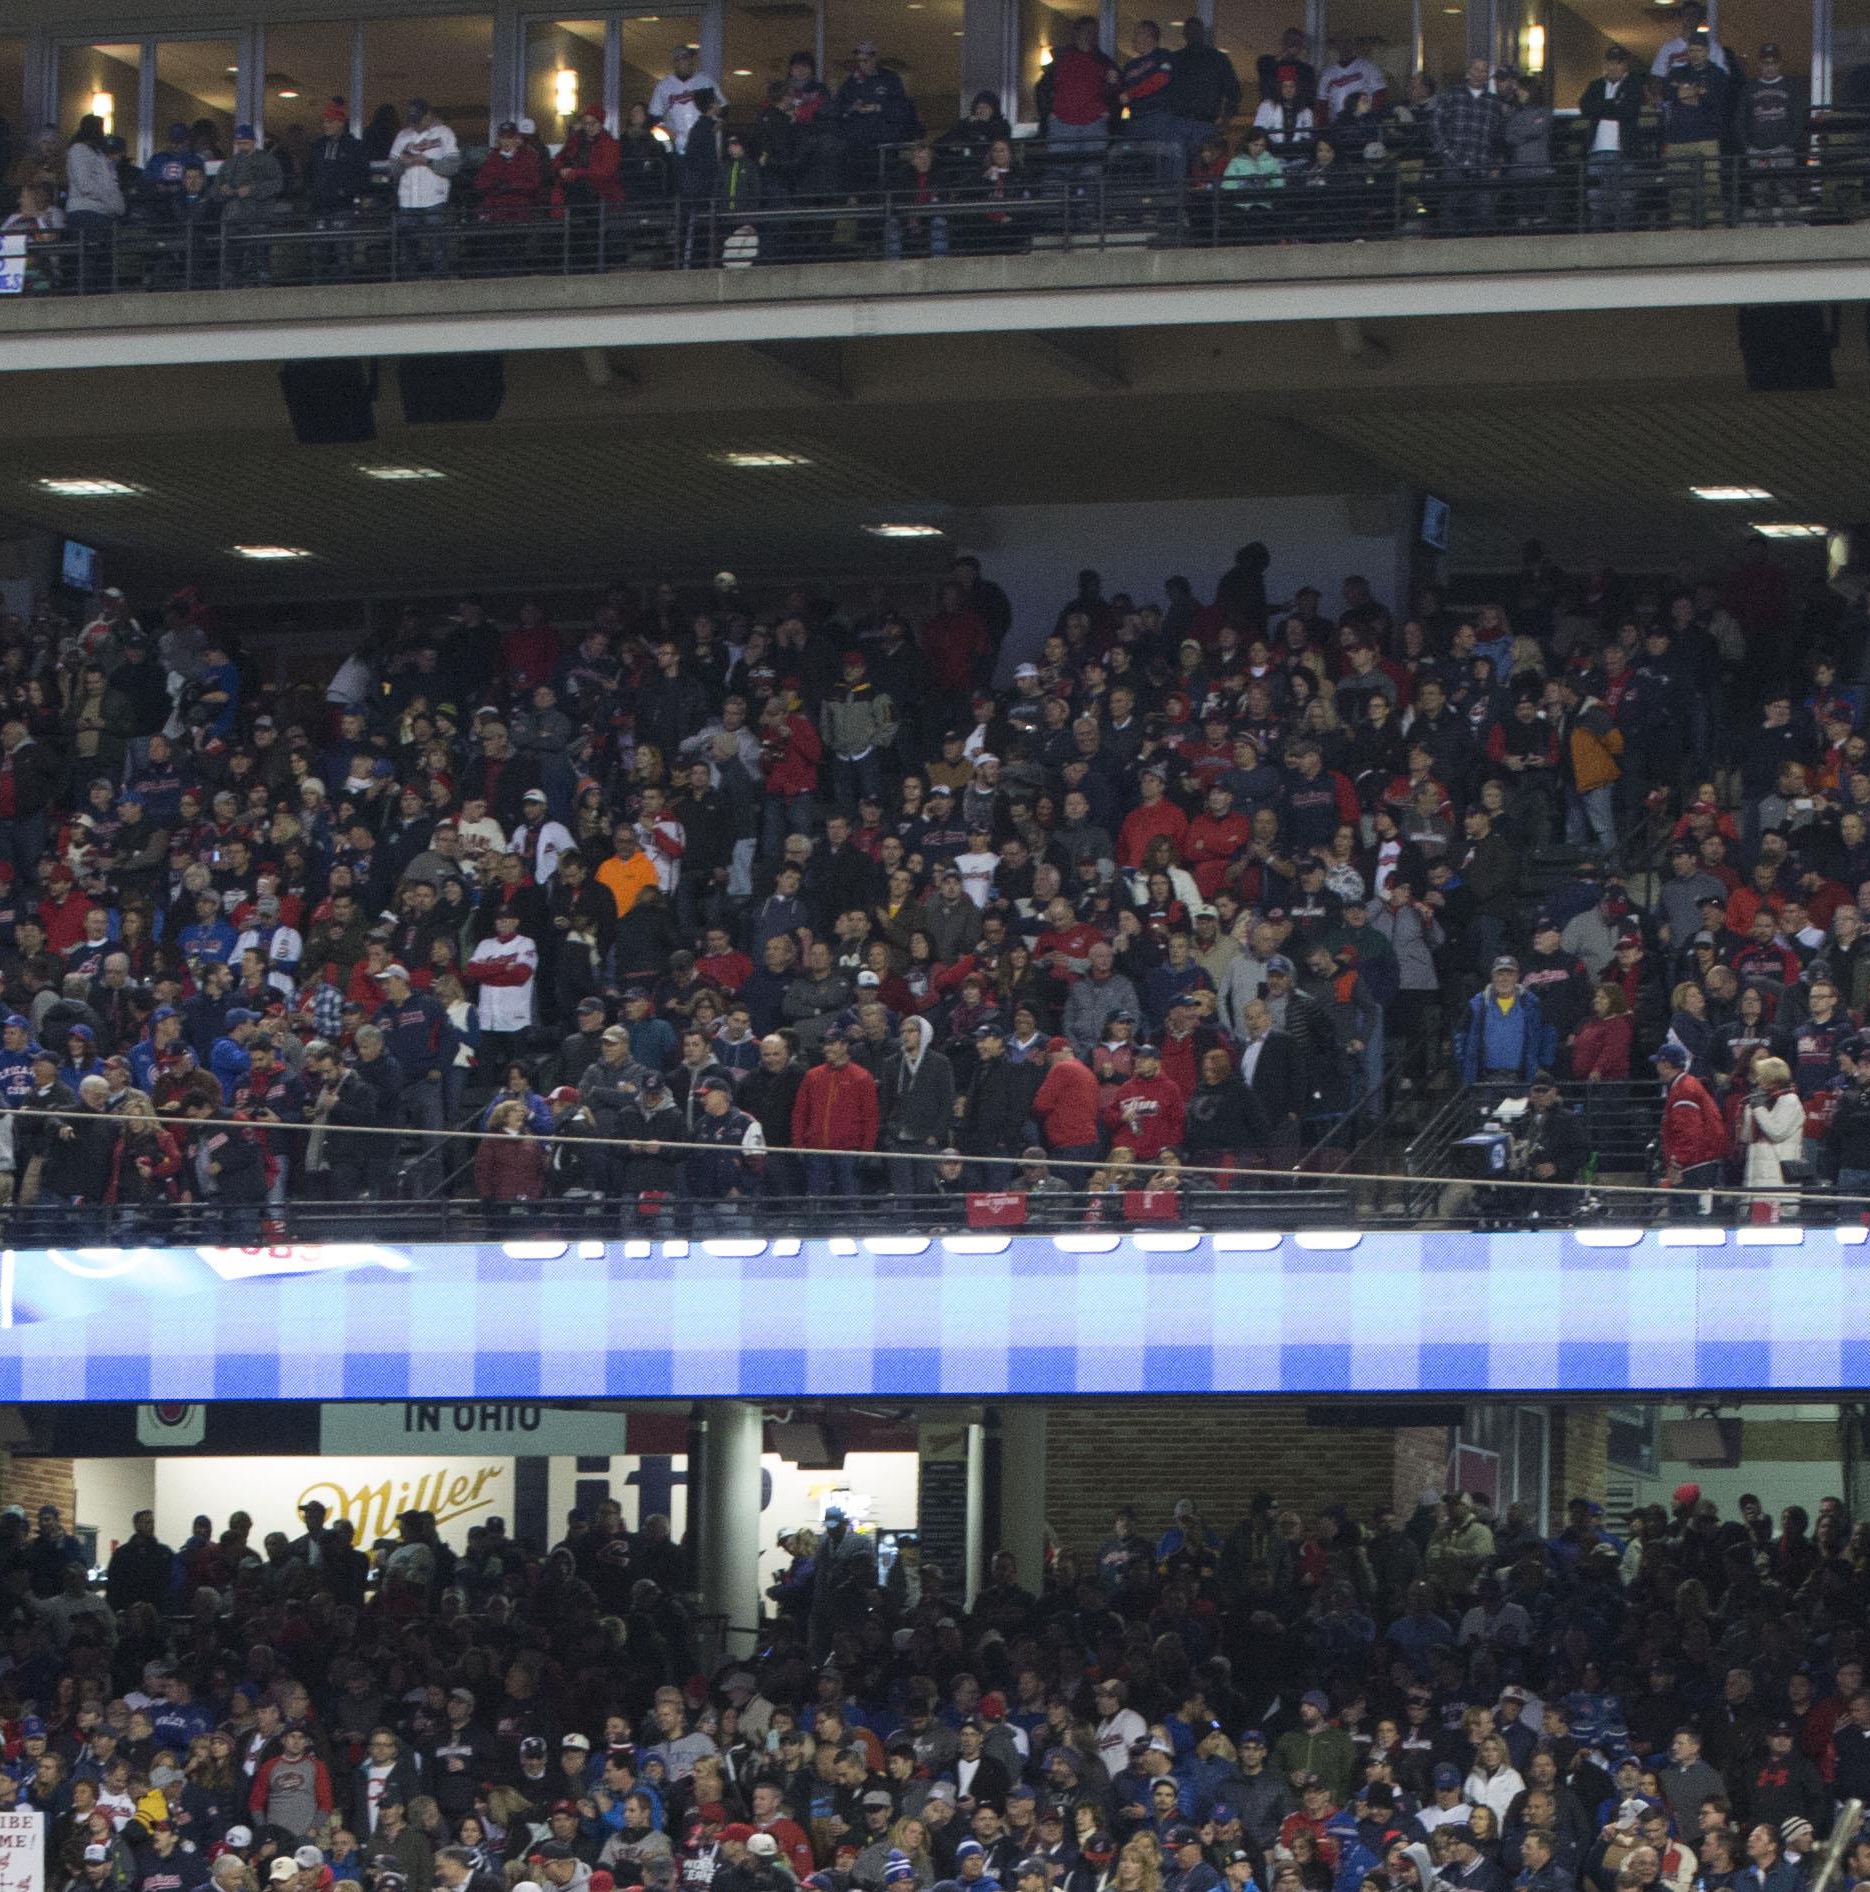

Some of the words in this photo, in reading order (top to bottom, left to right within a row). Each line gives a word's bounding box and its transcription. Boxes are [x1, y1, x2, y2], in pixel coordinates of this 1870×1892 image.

[405, 1405, 440, 1431] IN
[453, 1405, 541, 1431] OHIO
[298, 1465, 504, 1550] Miller
